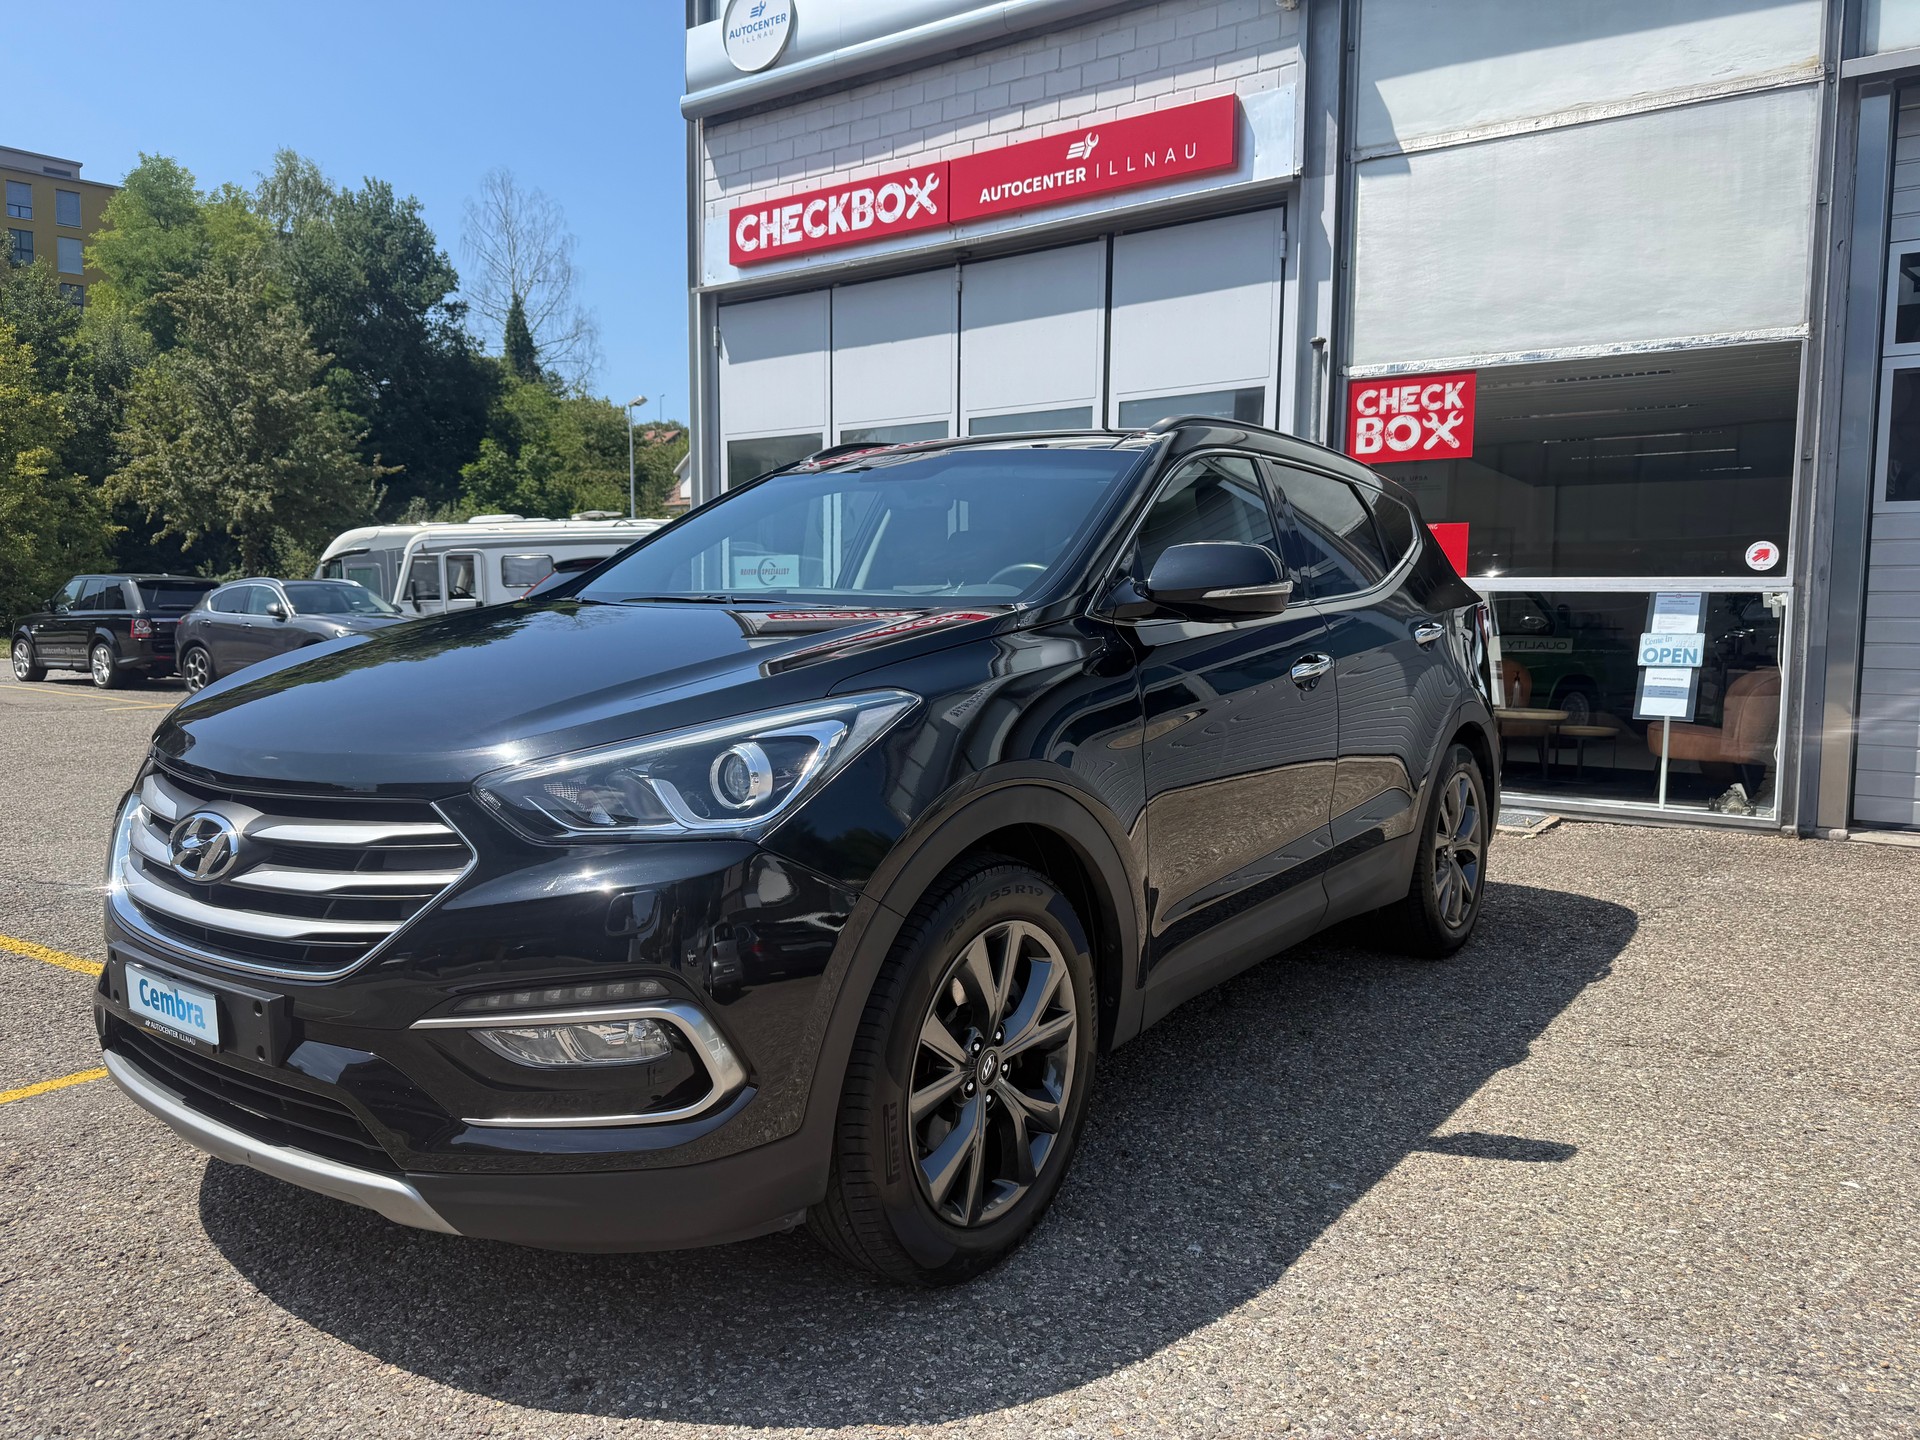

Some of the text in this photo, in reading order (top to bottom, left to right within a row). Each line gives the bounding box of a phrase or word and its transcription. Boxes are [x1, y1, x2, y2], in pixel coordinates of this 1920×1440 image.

[729, 13, 787, 39] AUTOCENTER
[742, 29, 774, 44] ILLNAU
[979, 142, 1196, 203] AUTOCENTER ILLNAU
[735, 172, 940, 252] CHECKBOX
[1356, 381, 1466, 416] CHECK
[1355, 410, 1464, 454] BOX
[1642, 647, 1698, 664] OPEN
[139, 978, 206, 1029] Cembra
[150, 1020, 196, 1046] AUTOCENTER ILLNAU
